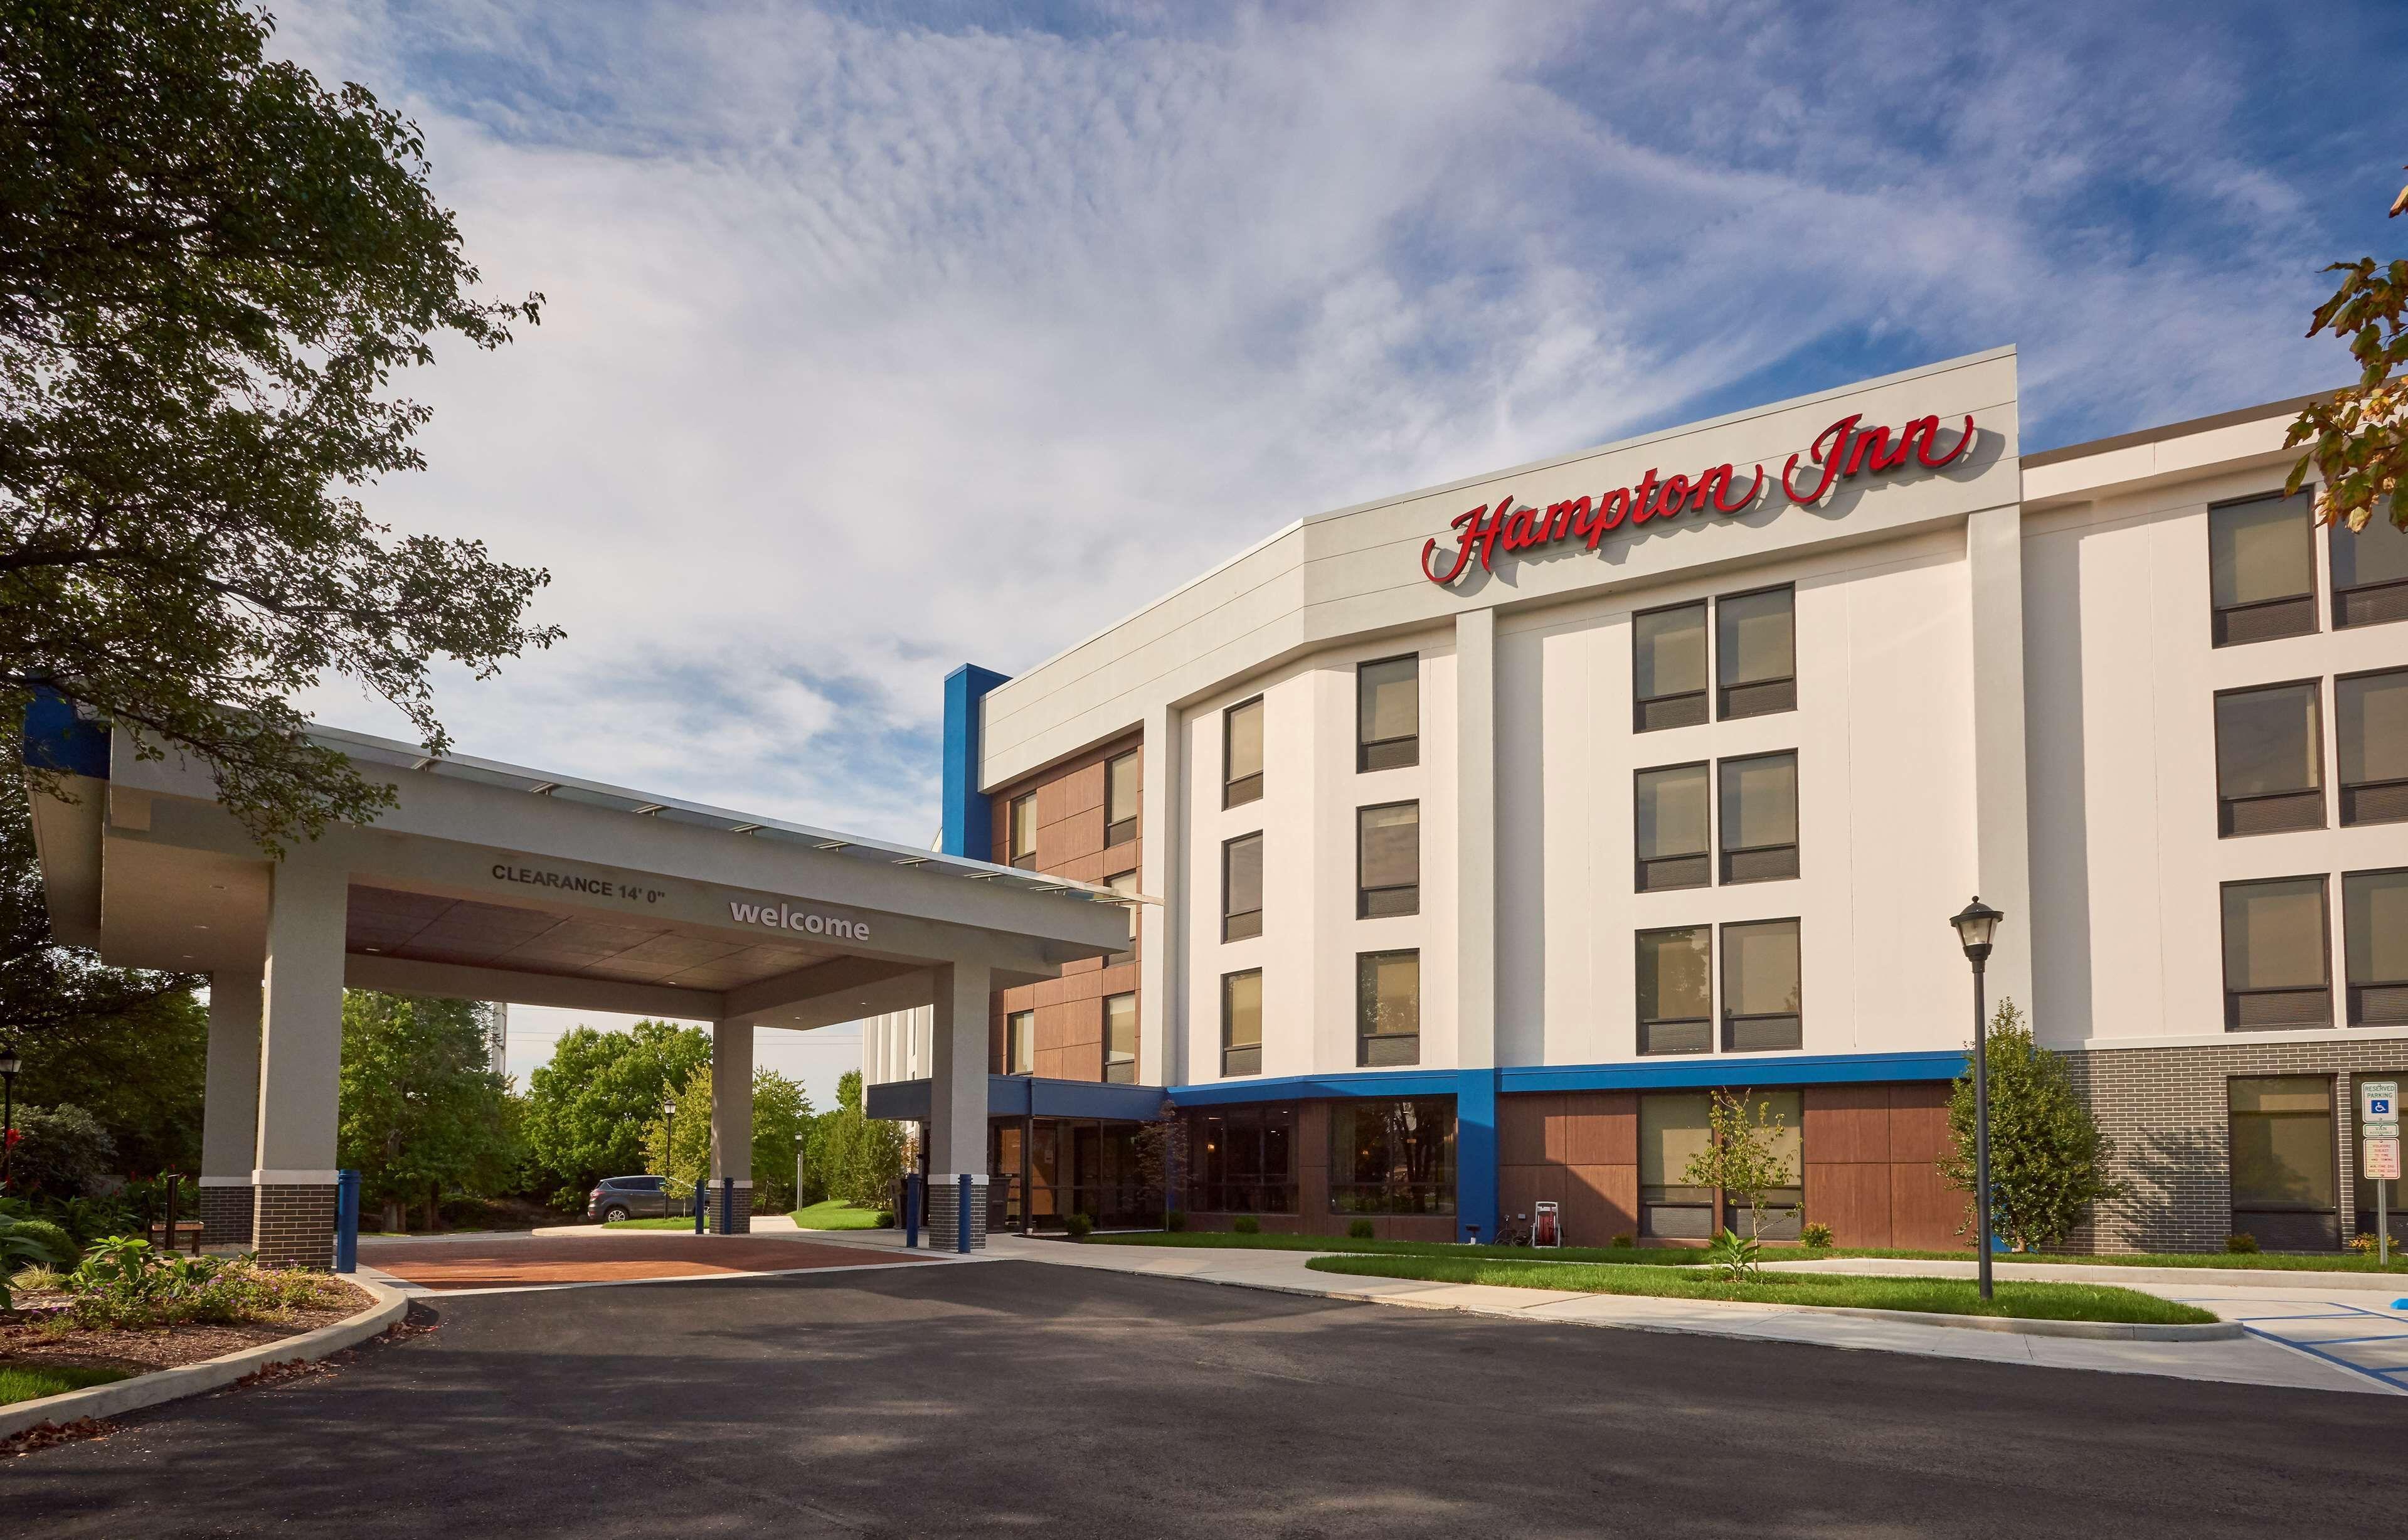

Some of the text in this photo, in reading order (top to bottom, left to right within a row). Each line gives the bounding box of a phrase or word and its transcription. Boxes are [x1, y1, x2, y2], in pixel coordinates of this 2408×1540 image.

[1421, 413, 1975, 585] Hampton Inn
[491, 864, 666, 903] CLEARANCE 14' 0"
[729, 901, 870, 941] welcome
